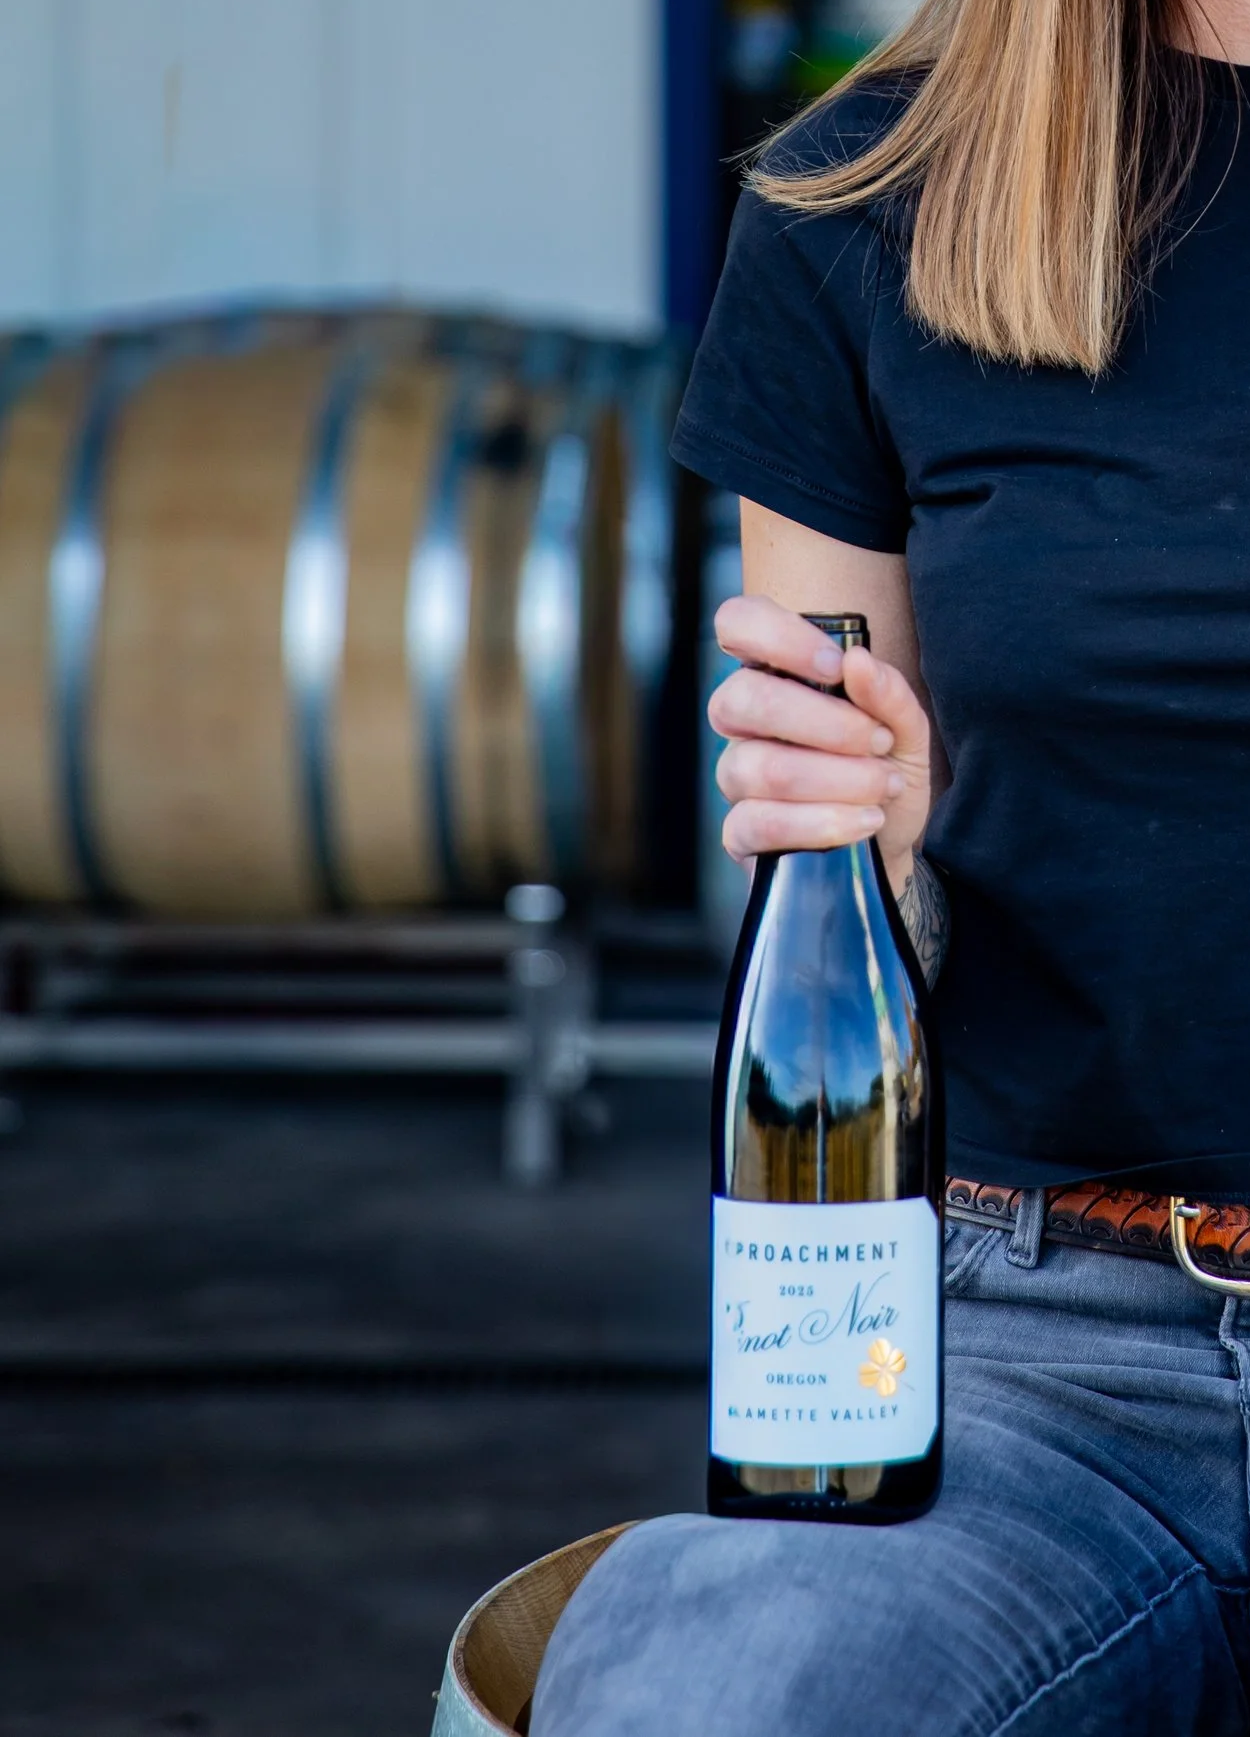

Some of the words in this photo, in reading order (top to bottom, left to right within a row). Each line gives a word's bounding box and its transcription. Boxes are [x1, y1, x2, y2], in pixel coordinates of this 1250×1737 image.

[779, 1284, 814, 1297] 2025
[798, 1270, 899, 1345] Noir
[765, 1372, 827, 1386] OREGON
[831, 1404, 899, 1422] VALLEY
